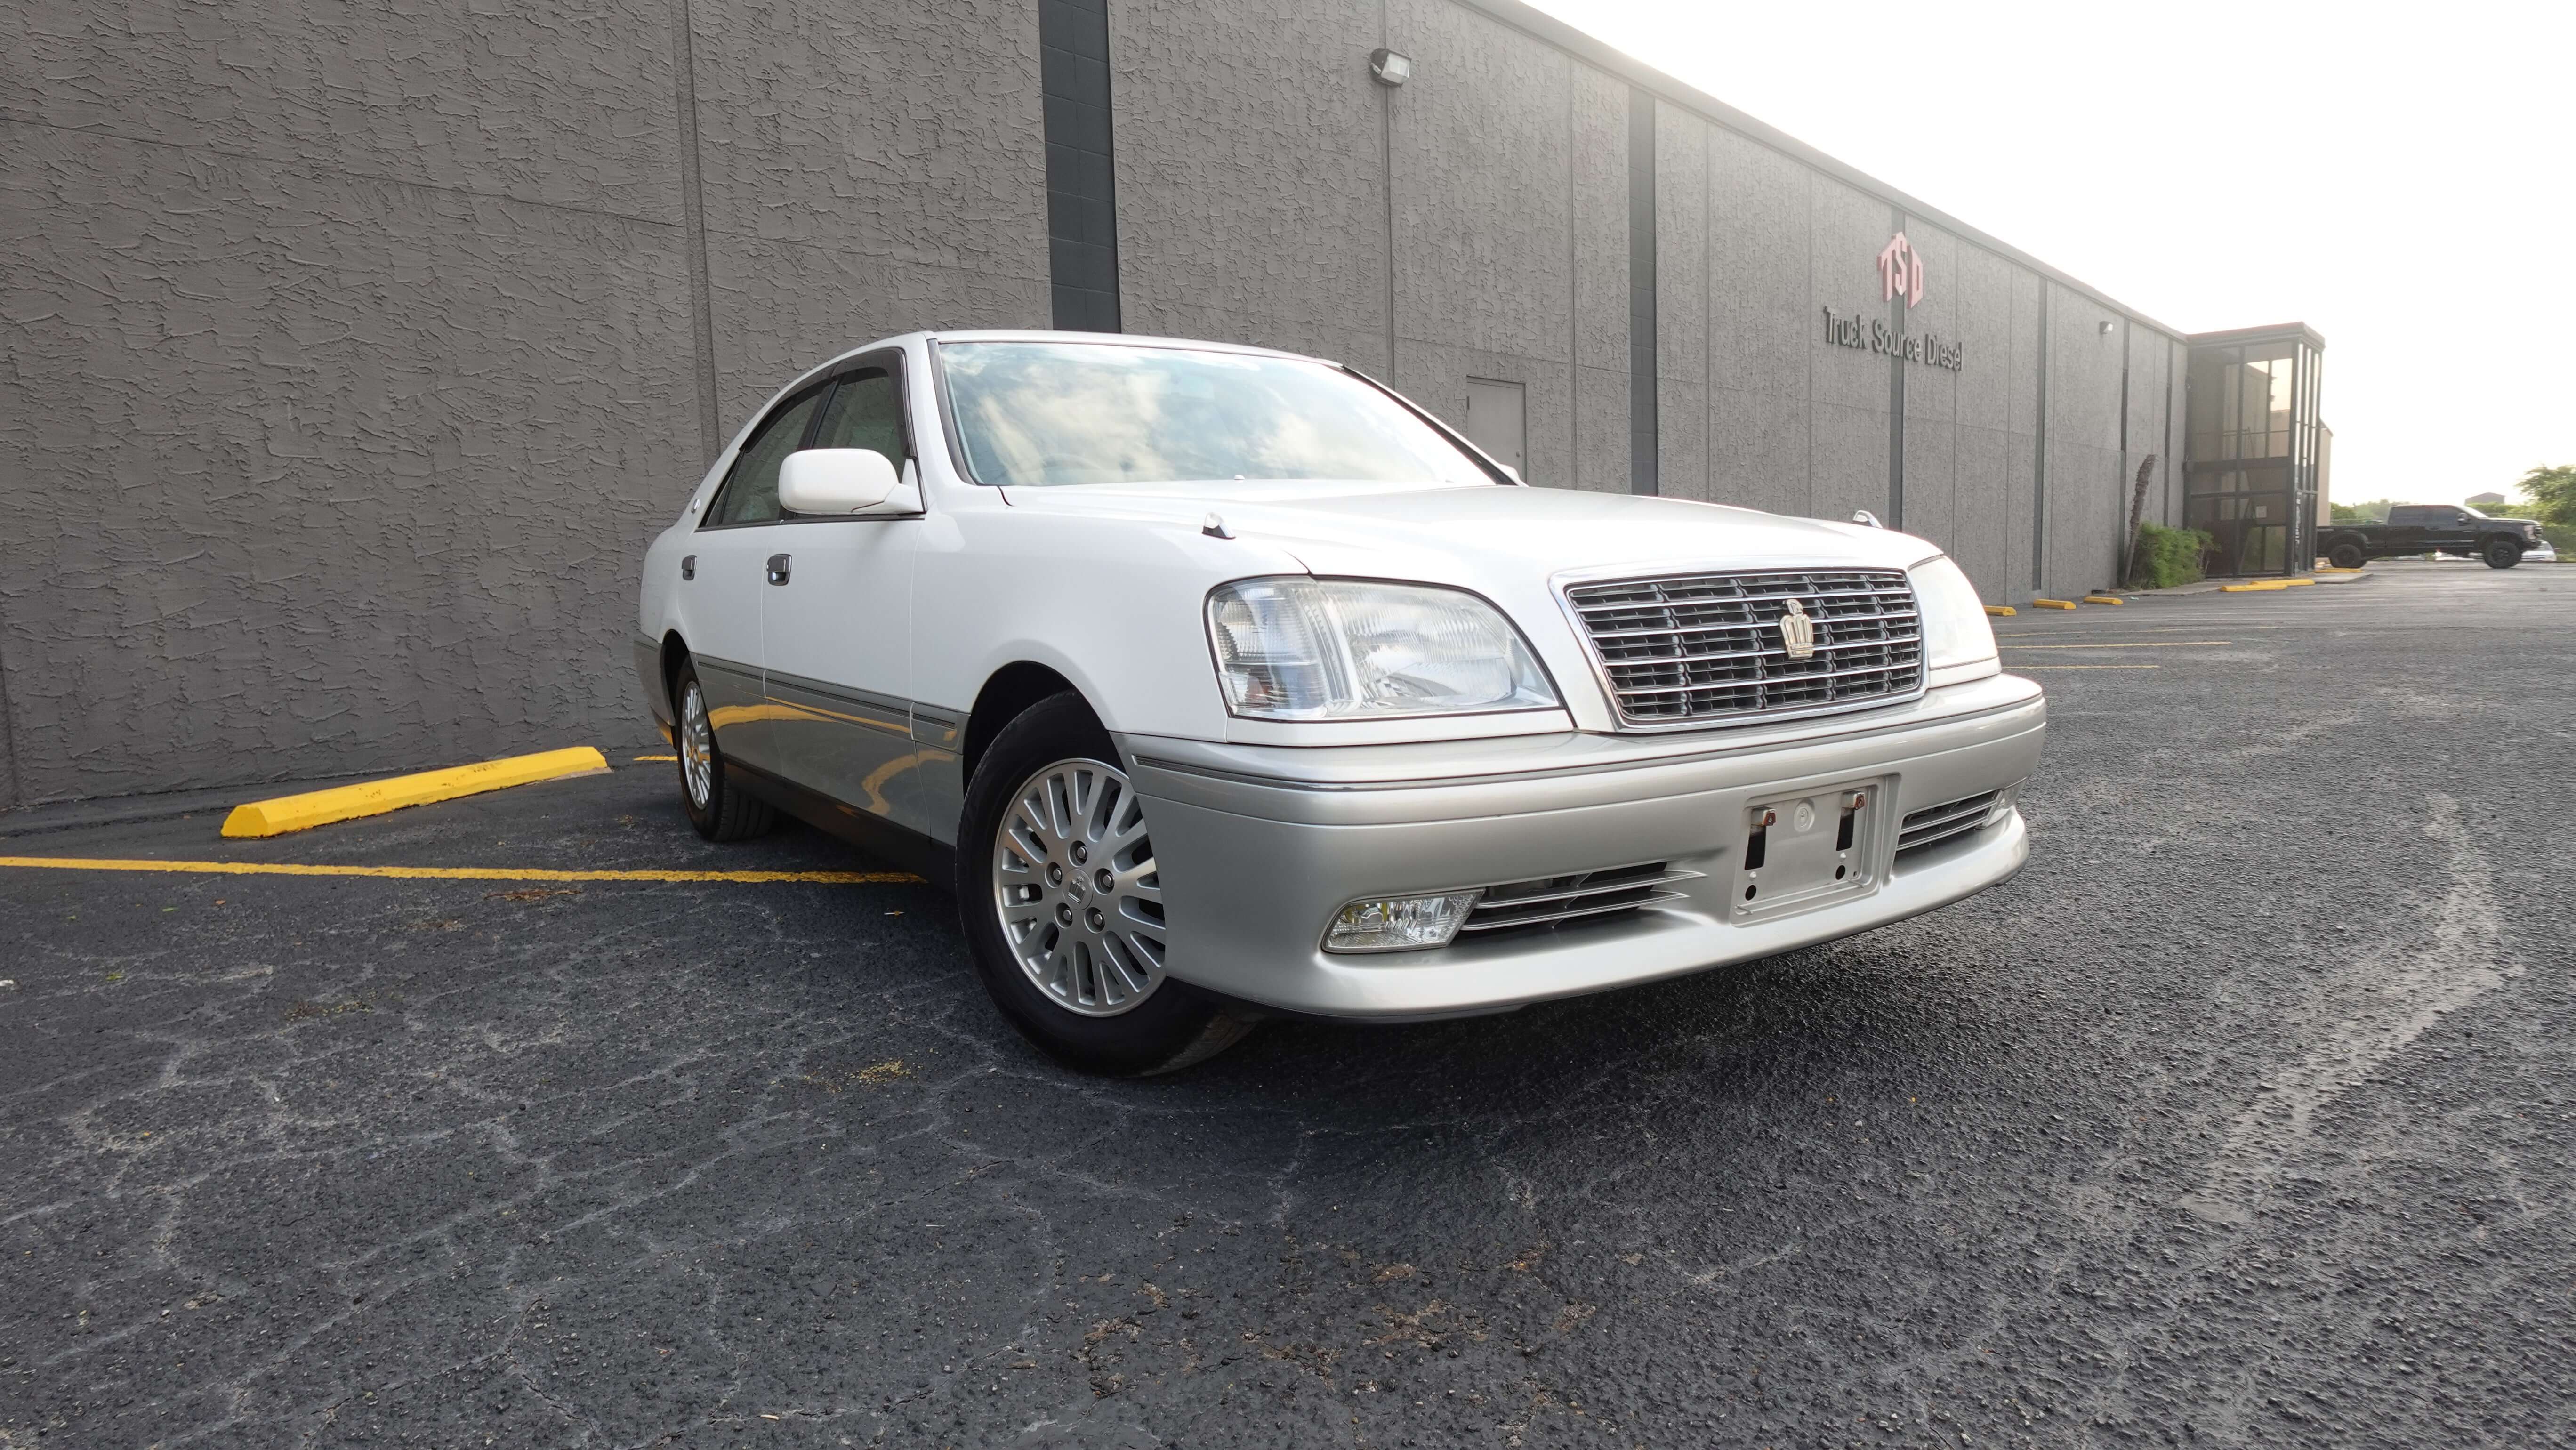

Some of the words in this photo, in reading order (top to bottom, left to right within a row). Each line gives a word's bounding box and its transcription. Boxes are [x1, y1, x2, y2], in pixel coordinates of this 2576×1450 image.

[1877, 231, 1923, 309] TSD
[1823, 306, 1867, 349] Truck
[1872, 319, 1921, 362] Source
[1925, 334, 1963, 371] Diesel
